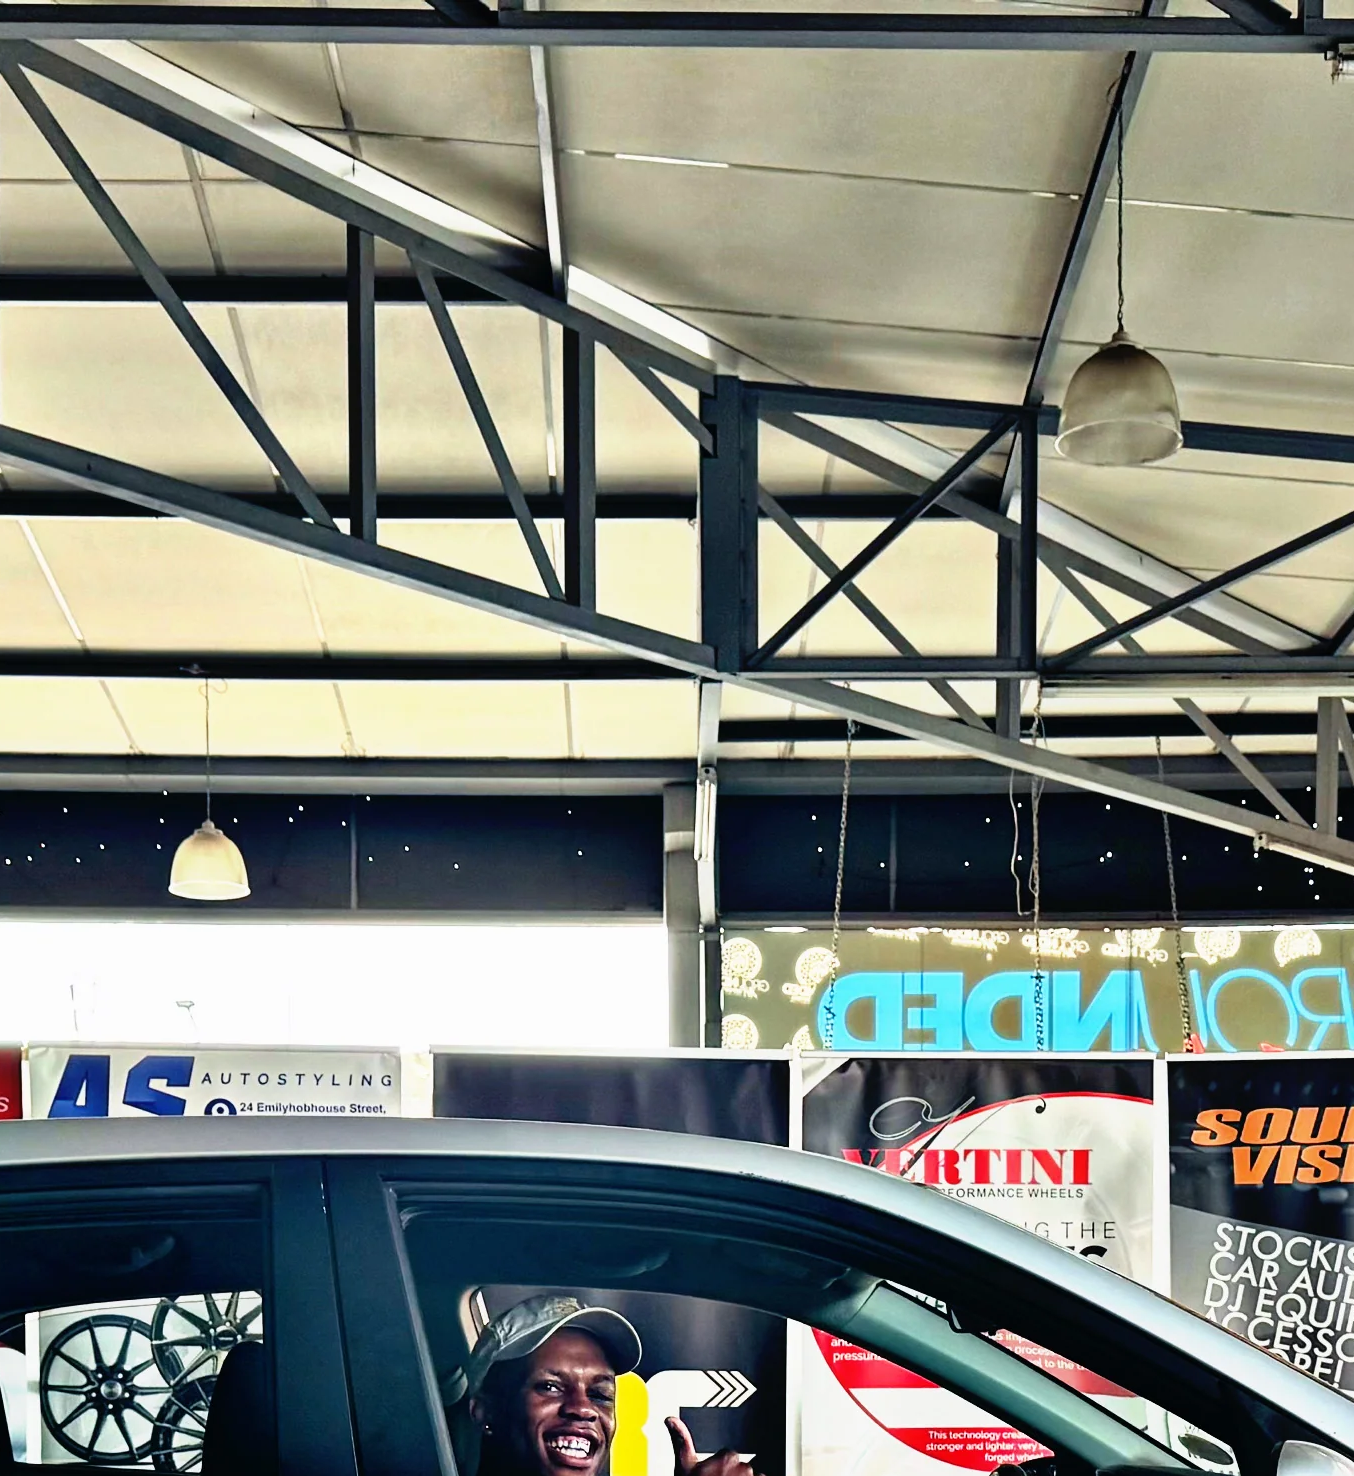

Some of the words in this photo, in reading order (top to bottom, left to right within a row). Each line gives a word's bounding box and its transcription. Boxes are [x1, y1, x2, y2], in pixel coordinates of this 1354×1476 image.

[48, 1054, 195, 1118] AS
[201, 1072, 392, 1087] AUTOSTYLING
[240, 1102, 253, 1112] 24
[257, 1102, 346, 1115] Emilyhobhouse
[349, 1103, 386, 1114] Street,
[1029, 1189, 1084, 1199] WHEELS
[1061, 1221, 1116, 1239] THE
[1210, 1252, 1279, 1290] CAR
[1203, 1278, 1244, 1311] DJ
[929, 1431, 947, 1439] This
[949, 1431, 1001, 1441] technology
[926, 1443, 964, 1452] stronger
[966, 1442, 983, 1450] and
